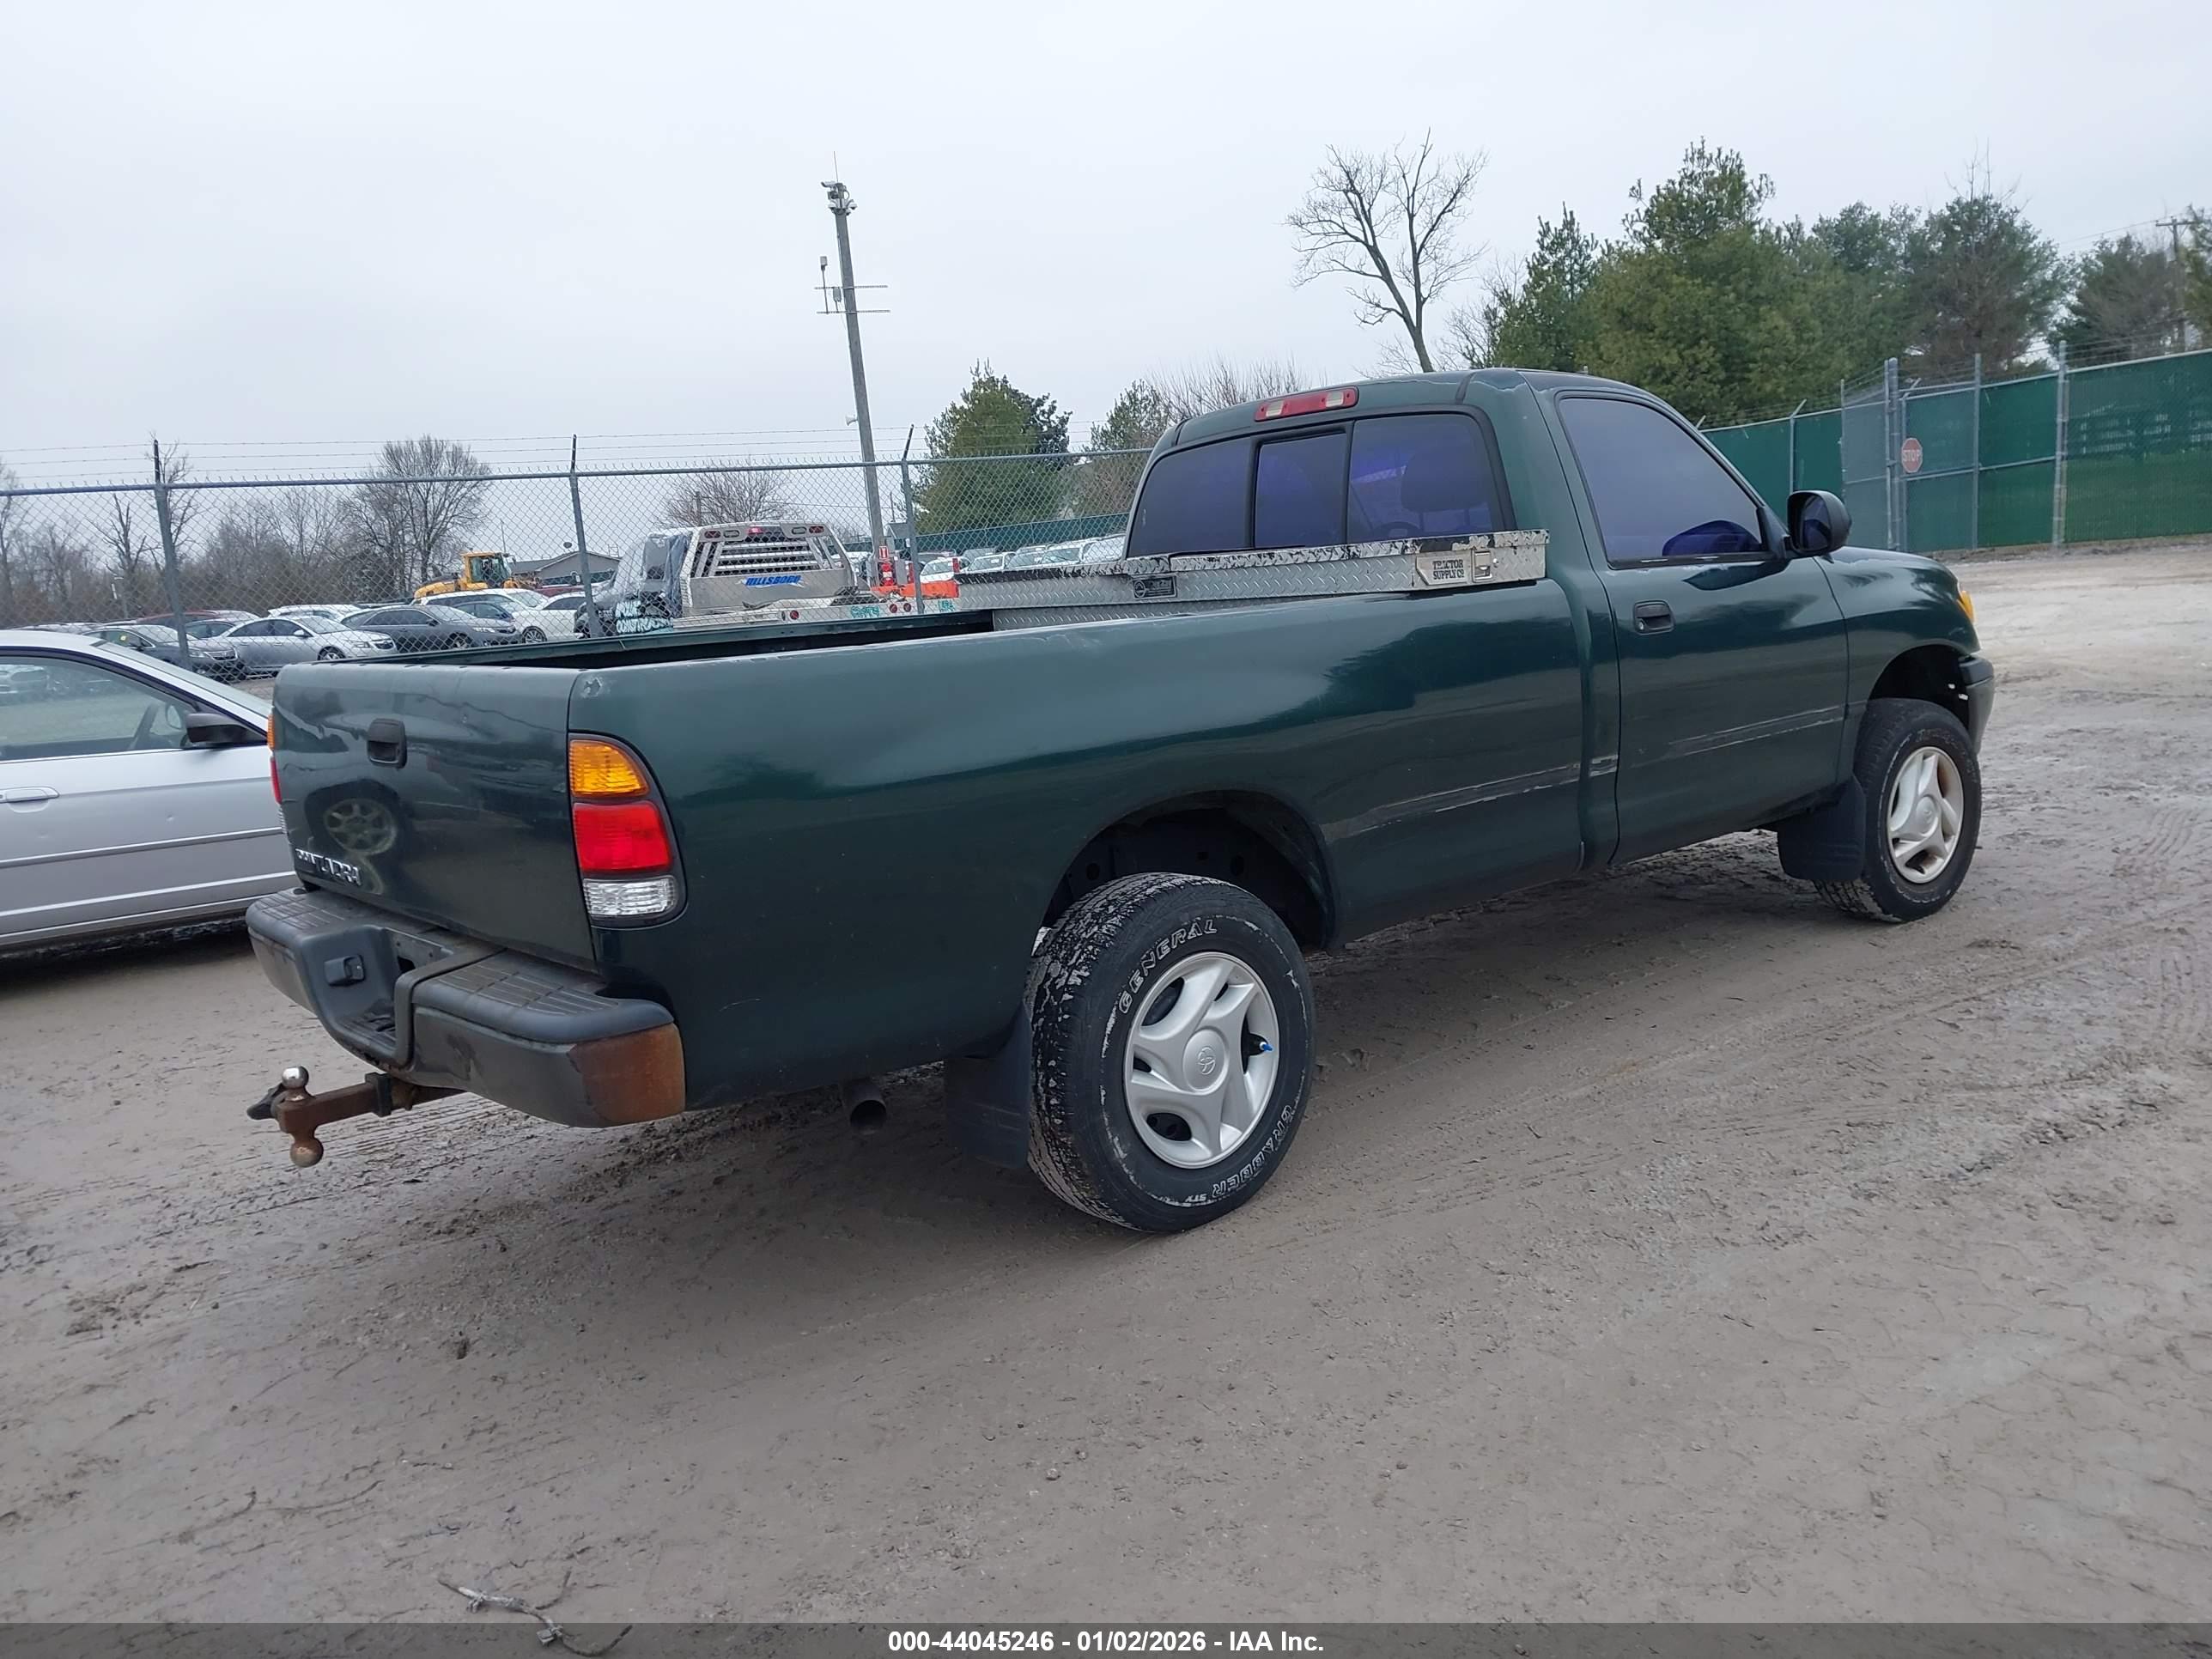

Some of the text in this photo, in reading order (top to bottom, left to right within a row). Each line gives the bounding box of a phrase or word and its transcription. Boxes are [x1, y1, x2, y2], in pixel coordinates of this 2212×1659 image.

[1902, 449, 1920, 462] STOP
[744, 574, 801, 586] HILLSBORO
[1432, 569, 1456, 580] SUPPLY
[1118, 919, 1218, 1013] GENERAL
[1212, 1104, 1293, 1199] GRABBER
